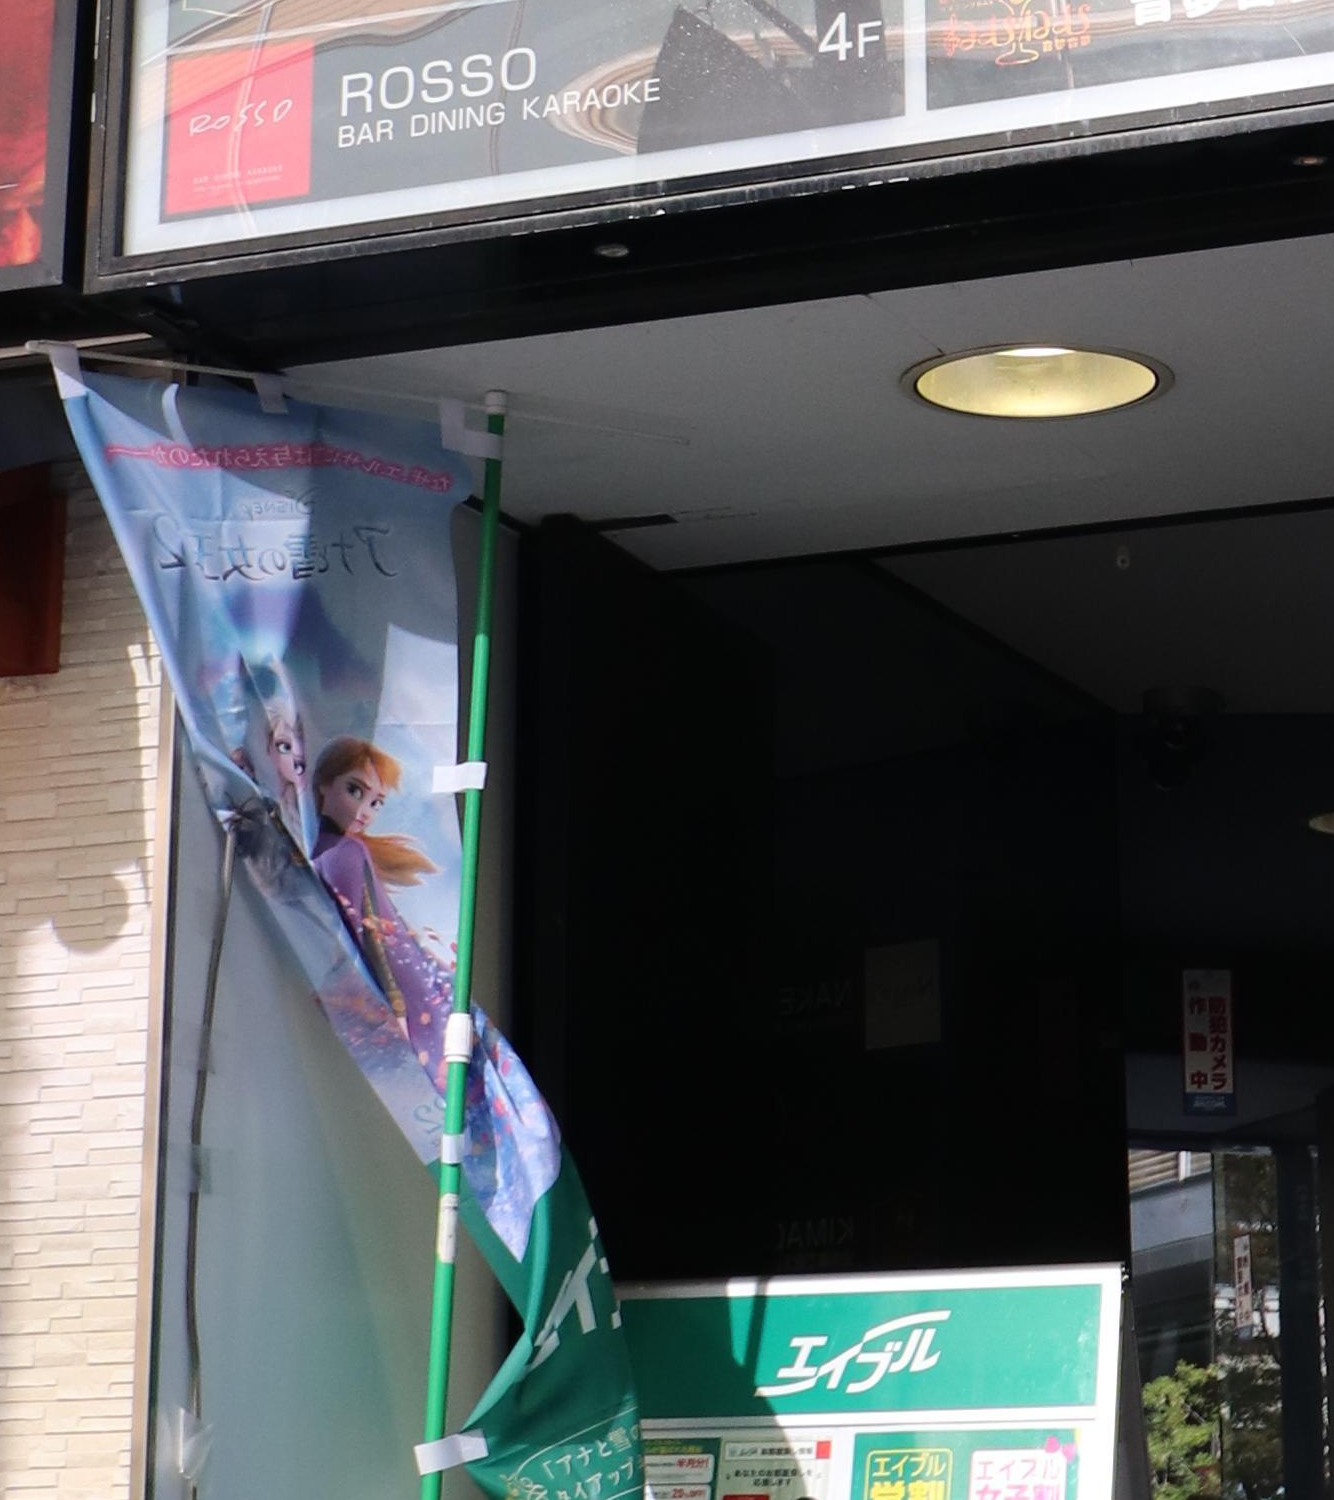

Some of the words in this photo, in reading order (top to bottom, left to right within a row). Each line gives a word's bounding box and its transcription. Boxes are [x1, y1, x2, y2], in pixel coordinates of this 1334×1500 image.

[339, 45, 538, 119] ROSSO
[817, 11, 882, 64] 4F
[188, 98, 294, 138] ROSSO
[337, 116, 395, 150] BAR
[409, 102, 507, 138] DINING
[522, 77, 662, 122] KARAOKE
[753, 1310, 952, 1399] エイブル
[871, 1452, 947, 1478] エイブル
